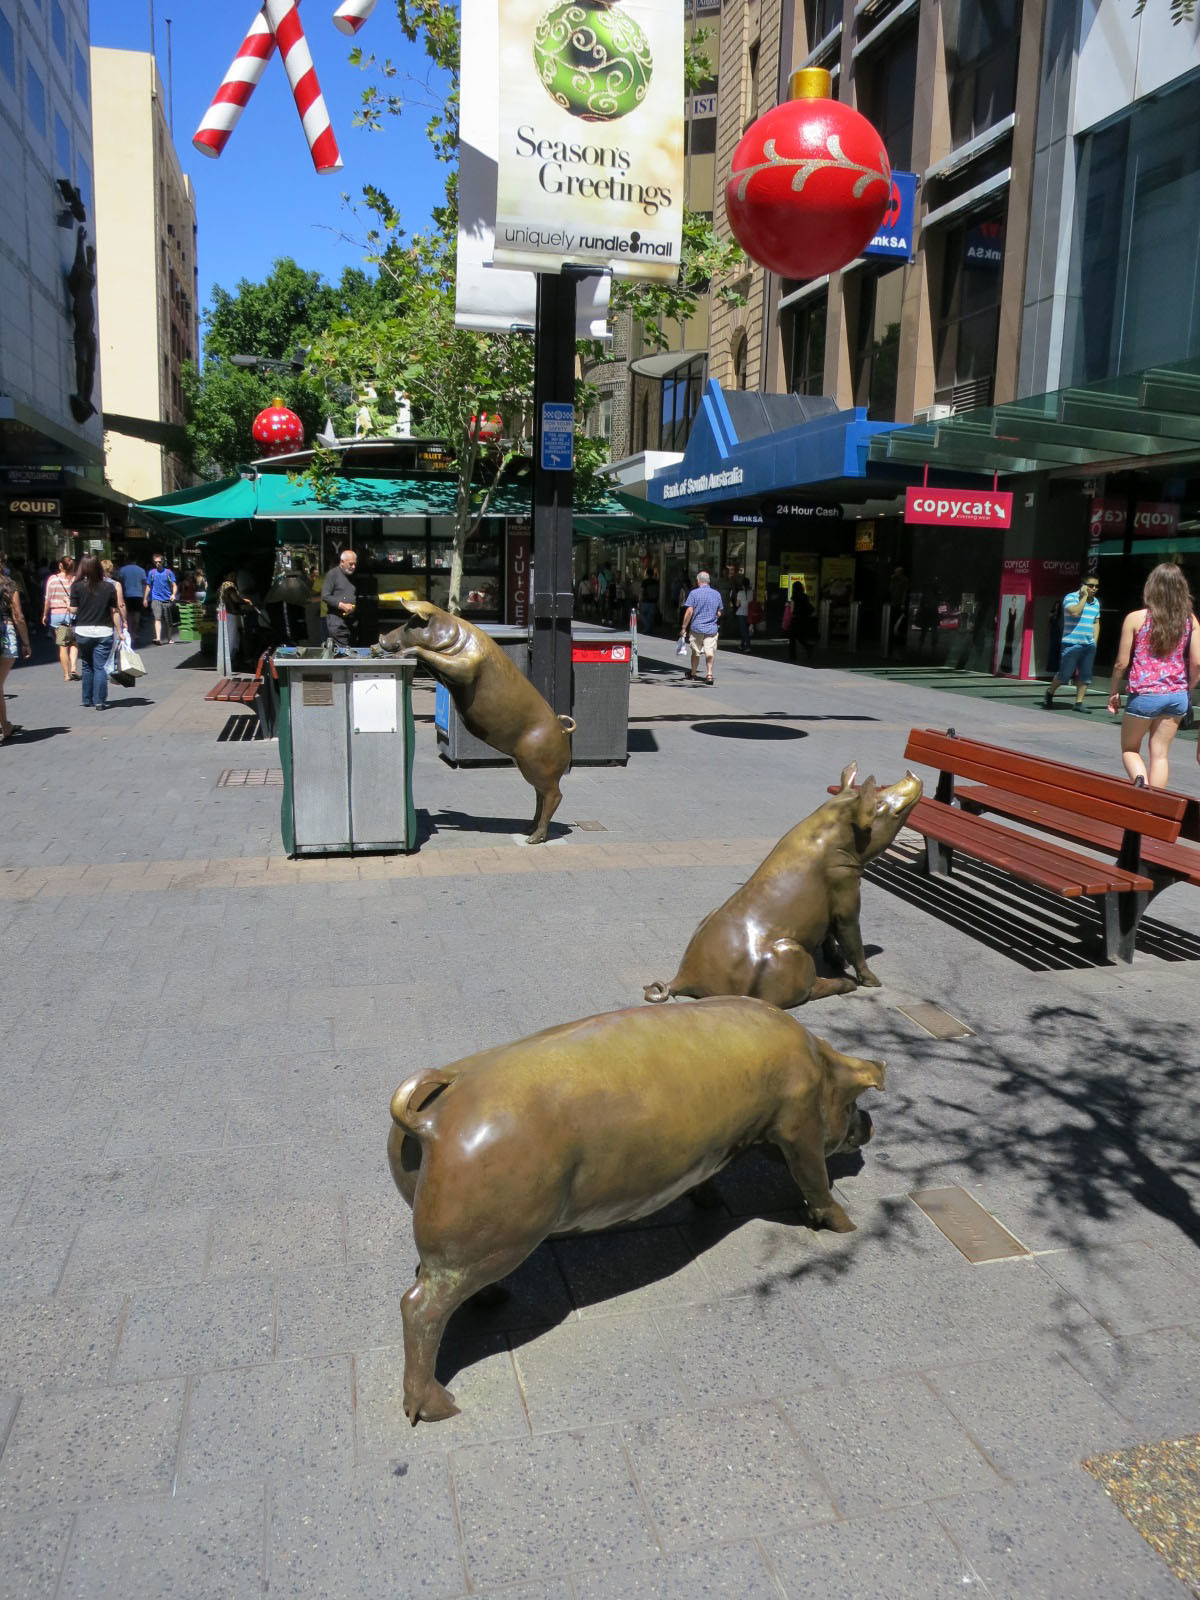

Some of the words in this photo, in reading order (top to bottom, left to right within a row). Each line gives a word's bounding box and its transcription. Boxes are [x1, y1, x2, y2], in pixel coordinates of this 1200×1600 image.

[693, 98, 717, 114] IST
[515, 125, 632, 171] Season's
[538, 163, 673, 217] Greetings
[504, 227, 575, 248] uniquely
[869, 235, 907, 249] ankSA
[663, 482, 680, 500] Bank
[679, 478, 688, 496] of
[687, 474, 709, 494] South
[708, 466, 744, 489] Australia
[9, 500, 56, 513] eQUIP
[776, 504, 789, 514] 24
[791, 505, 814, 516] Hour
[815, 506, 839, 517] Cash
[913, 498, 992, 519] copycat
[732, 514, 764, 523] BankSA
[325, 525, 349, 534] FREE
